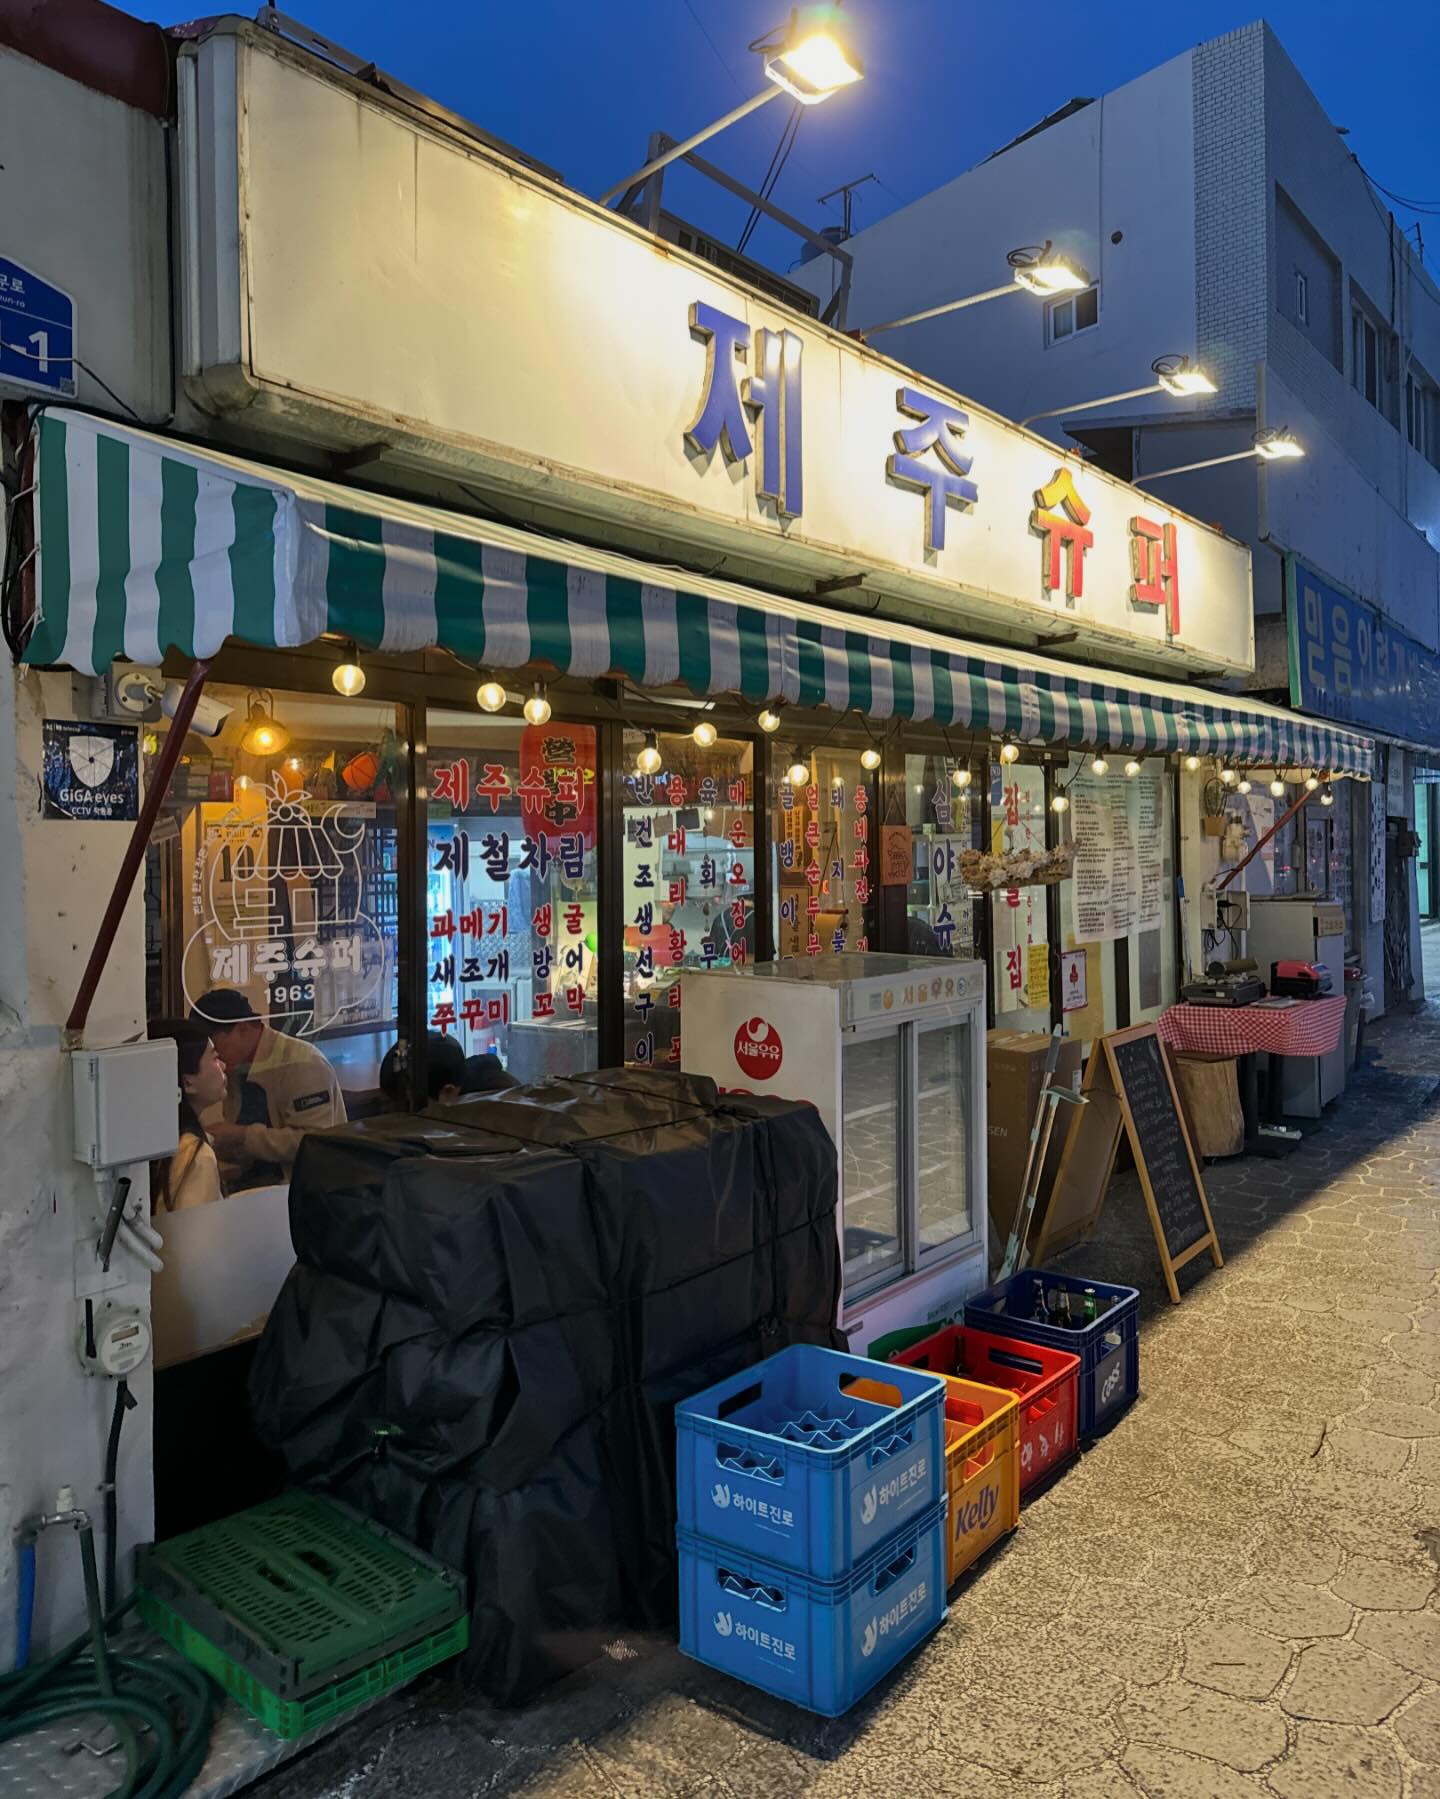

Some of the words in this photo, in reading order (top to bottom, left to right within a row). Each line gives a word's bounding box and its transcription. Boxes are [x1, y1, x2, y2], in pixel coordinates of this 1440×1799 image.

[0, 322, 48, 374] -1
[684, 300, 1180, 635] 제주슈퍼
[60, 788, 93, 803] GiGA
[94, 793, 125, 805] eyes
[431, 758, 585, 815] 제주슈퍼
[71, 806, 92, 815] CCTV
[433, 831, 585, 882] 제철차림
[779, 783, 796, 960] 골뱅이
[805, 783, 822, 956] 얼큰순두부
[430, 906, 508, 943] 과메기
[211, 935, 362, 984] 제주슈퍼
[430, 949, 509, 989] 새조개
[264, 984, 316, 1004] 1963
[902, 976, 955, 1005] 서울우유
[430, 992, 509, 1040] 쭈꾸미
[736, 1041, 781, 1060] 서울우유
[879, 1458, 927, 1505] 하이트진로
[732, 1492, 795, 1527] 하이트진로
[955, 1484, 999, 1542] Kelly
[879, 1583, 927, 1636] 하이트진로
[735, 1623, 797, 1660] 하이트진로
